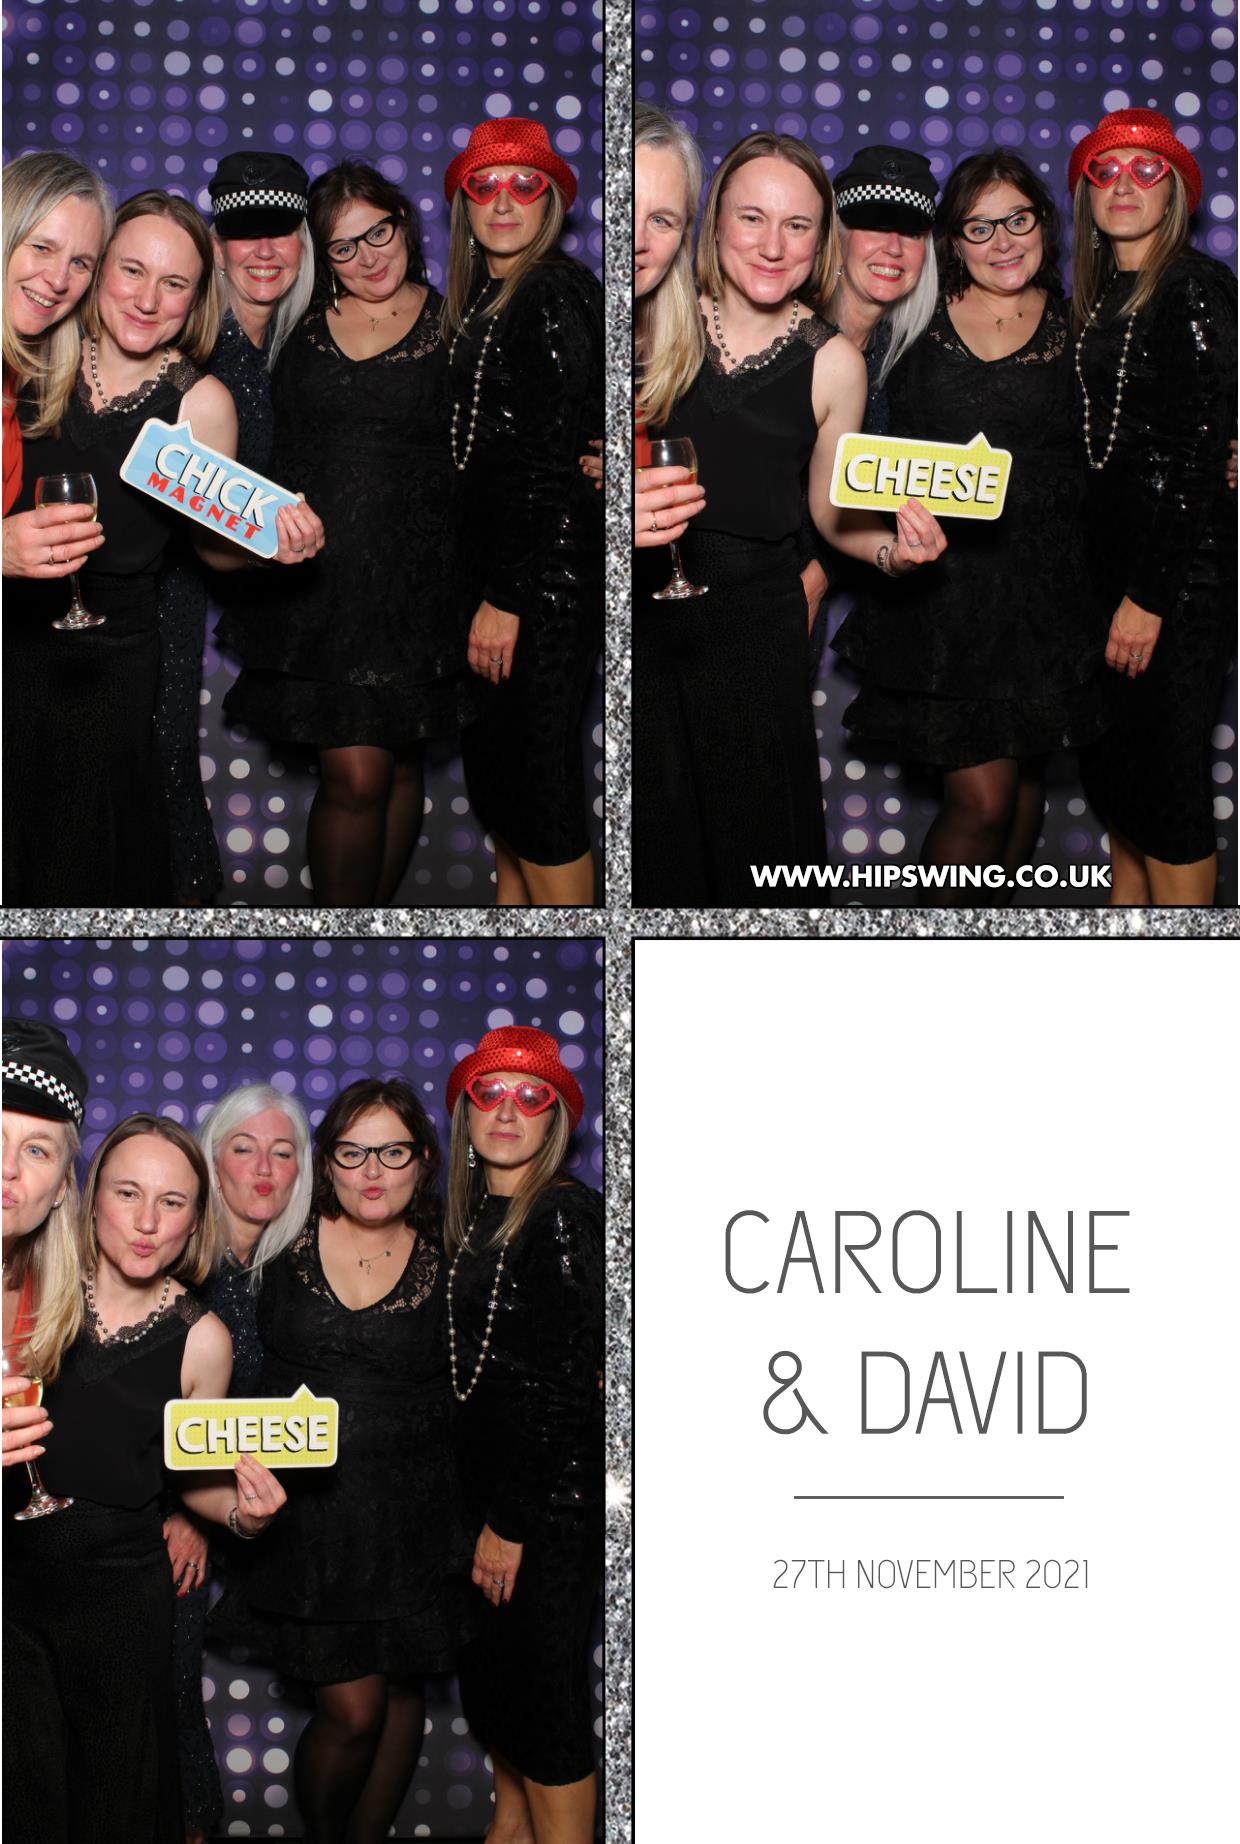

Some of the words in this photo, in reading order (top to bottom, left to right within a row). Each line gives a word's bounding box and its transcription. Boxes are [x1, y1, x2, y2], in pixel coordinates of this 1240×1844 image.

[146, 471, 262, 540] MAGNET
[155, 443, 279, 529] CHICK
[845, 453, 1000, 504] CHEESE
[176, 1415, 329, 1455] CHEESE
